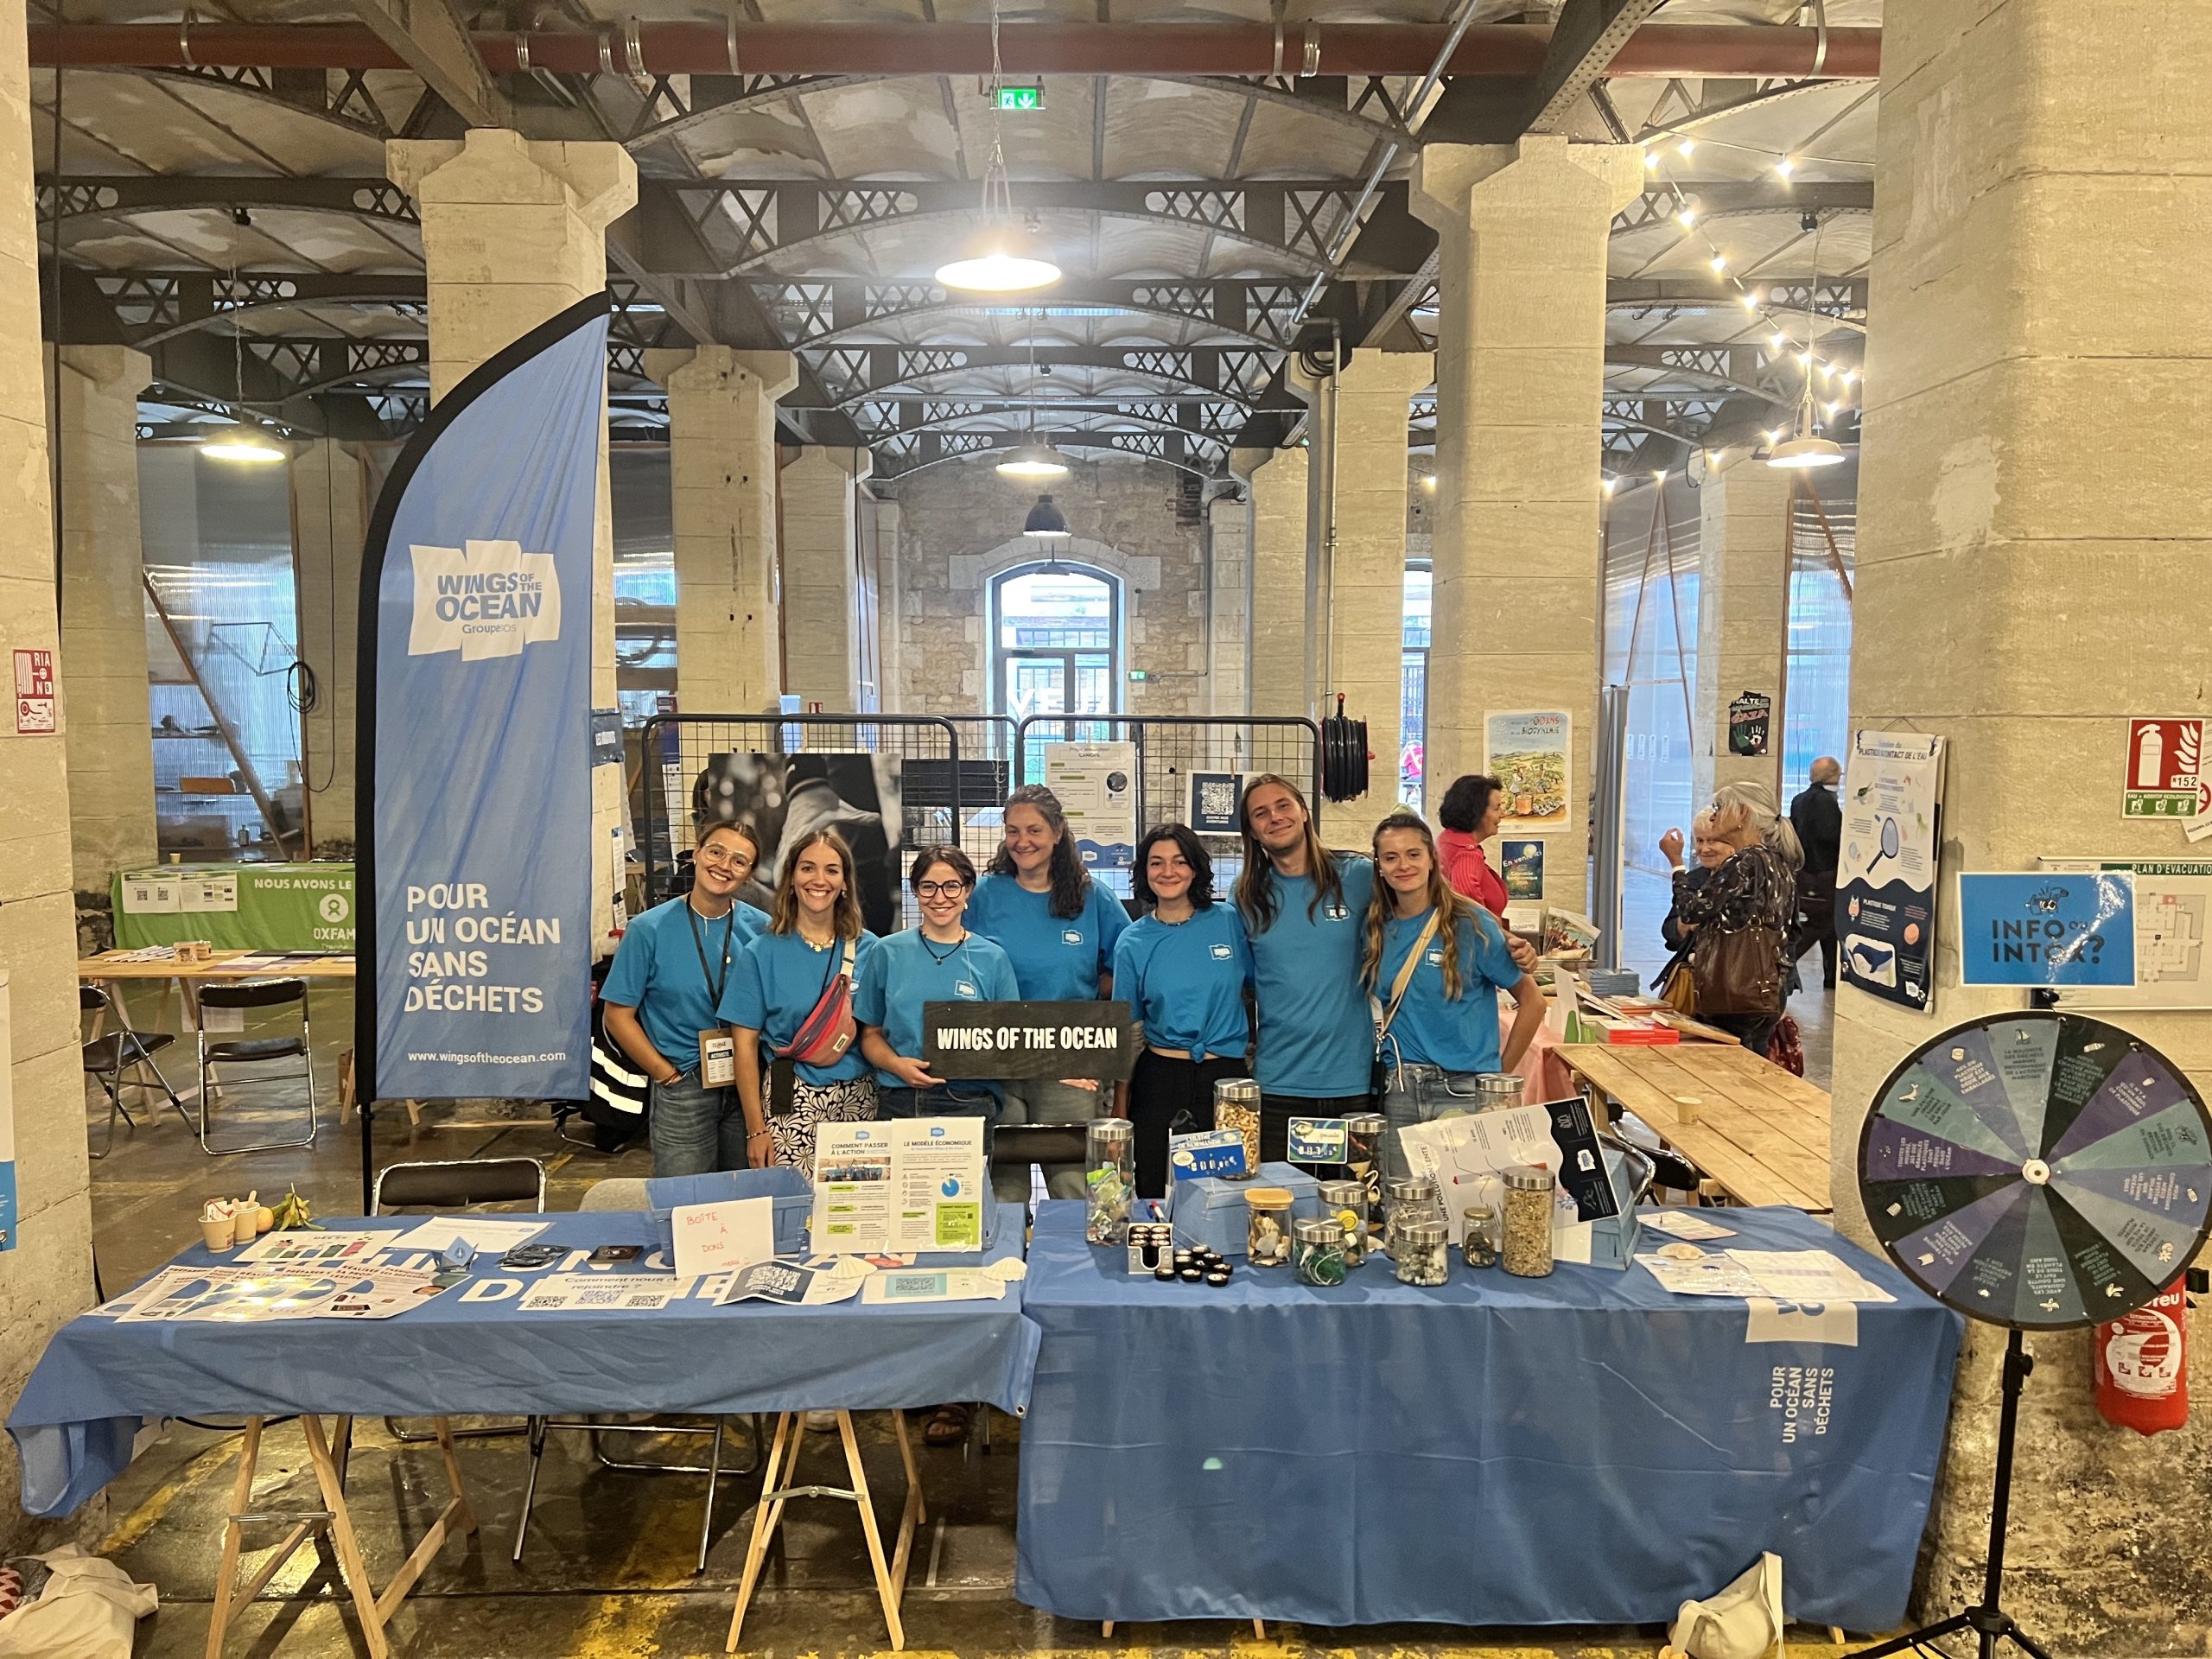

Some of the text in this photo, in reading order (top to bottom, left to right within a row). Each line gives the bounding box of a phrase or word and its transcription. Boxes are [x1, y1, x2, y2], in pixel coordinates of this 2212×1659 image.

[437, 573, 518, 594] WINGS
[520, 582, 542, 591] THE
[435, 593, 542, 622] OCEAN
[34, 652, 51, 666] RIA
[2132, 864, 2212, 874] PLAN D'EVACUATIO
[254, 879, 353, 890] NOUS AVONS LE
[407, 883, 489, 912] POUR
[313, 927, 356, 940] OXFAM
[406, 911, 561, 944] UN OCÉAN
[1992, 918, 2065, 940] INFO
[408, 950, 487, 977] SANS
[404, 978, 543, 1013] DÉCHETS
[938, 1027, 1117, 1051] WINGS OF THE OCEAN
[408, 1050, 566, 1065] www.wingsoftheocean.com
[1954, 1061, 1983, 1079] PLASTIQUE
[1959, 1066, 1985, 1083] NEUF EST
[1977, 1070, 1990, 1079] AUX
[2059, 1071, 2093, 1086] PLASTIQUE
[1961, 1073, 1996, 1094] EMBALLAGES
[2113, 1092, 2139, 1116] PLASTIQUE
[2114, 1084, 2142, 1110] CONTINENT
[1421, 1146, 1432, 1167] LENTE
[1440, 1206, 1449, 1222] UNE
[701, 1242, 724, 1253] DONS
[1933, 1231, 1961, 1255] PLASTIQUE
[1770, 1366, 1786, 1408] POUR
[1802, 1368, 1818, 1408] SANS
[1782, 1367, 1802, 1443] UN OCÉAN
[1814, 1368, 1834, 1434] DÉCHETS
